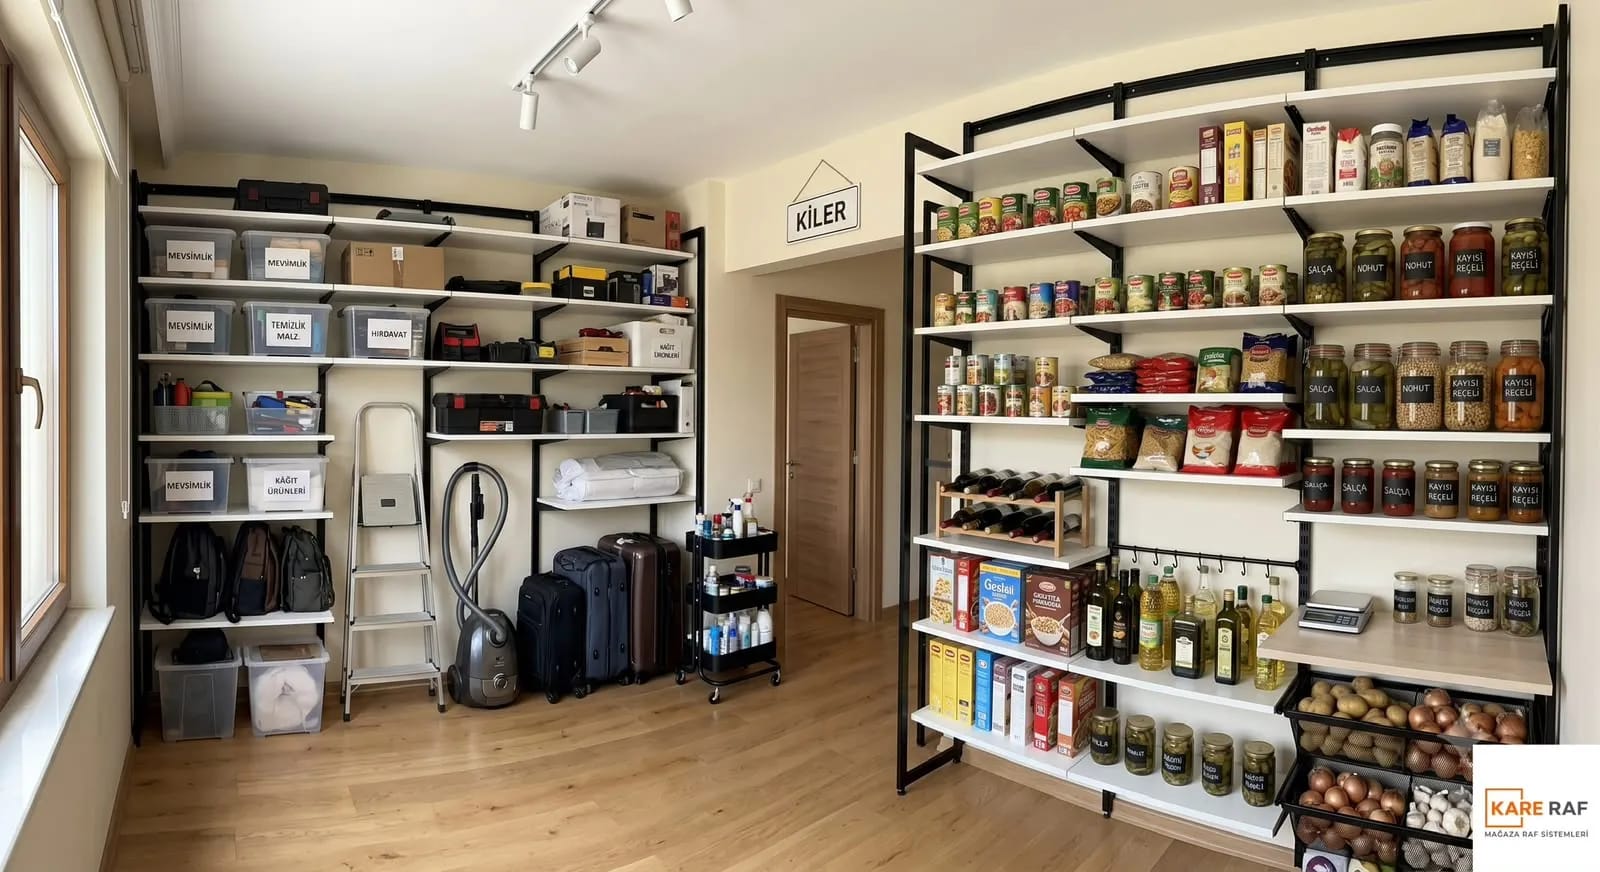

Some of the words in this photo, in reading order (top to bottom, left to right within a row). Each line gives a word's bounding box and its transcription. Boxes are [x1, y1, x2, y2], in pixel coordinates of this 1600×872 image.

[796, 200, 847, 232] KİLER
[168, 251, 213, 261] MEVSİMLİK
[1308, 264, 1333, 275] SALÇA
[1357, 263, 1384, 273] NOHUT
[1405, 261, 1433, 270] NOHUT
[168, 320, 213, 331] MEVSİMLİK
[271, 319, 306, 331] TEMİZLİK
[371, 330, 408, 338] HIRDAVAT
[1402, 384, 1430, 393] NOHUT
[167, 480, 212, 490] MEVSİMLİK
[1342, 483, 1367, 495] SALÇA
[1428, 482, 1452, 491] KAYISI
[1471, 484, 1497, 492] KAYISI
[1512, 485, 1538, 494] KAYISI
